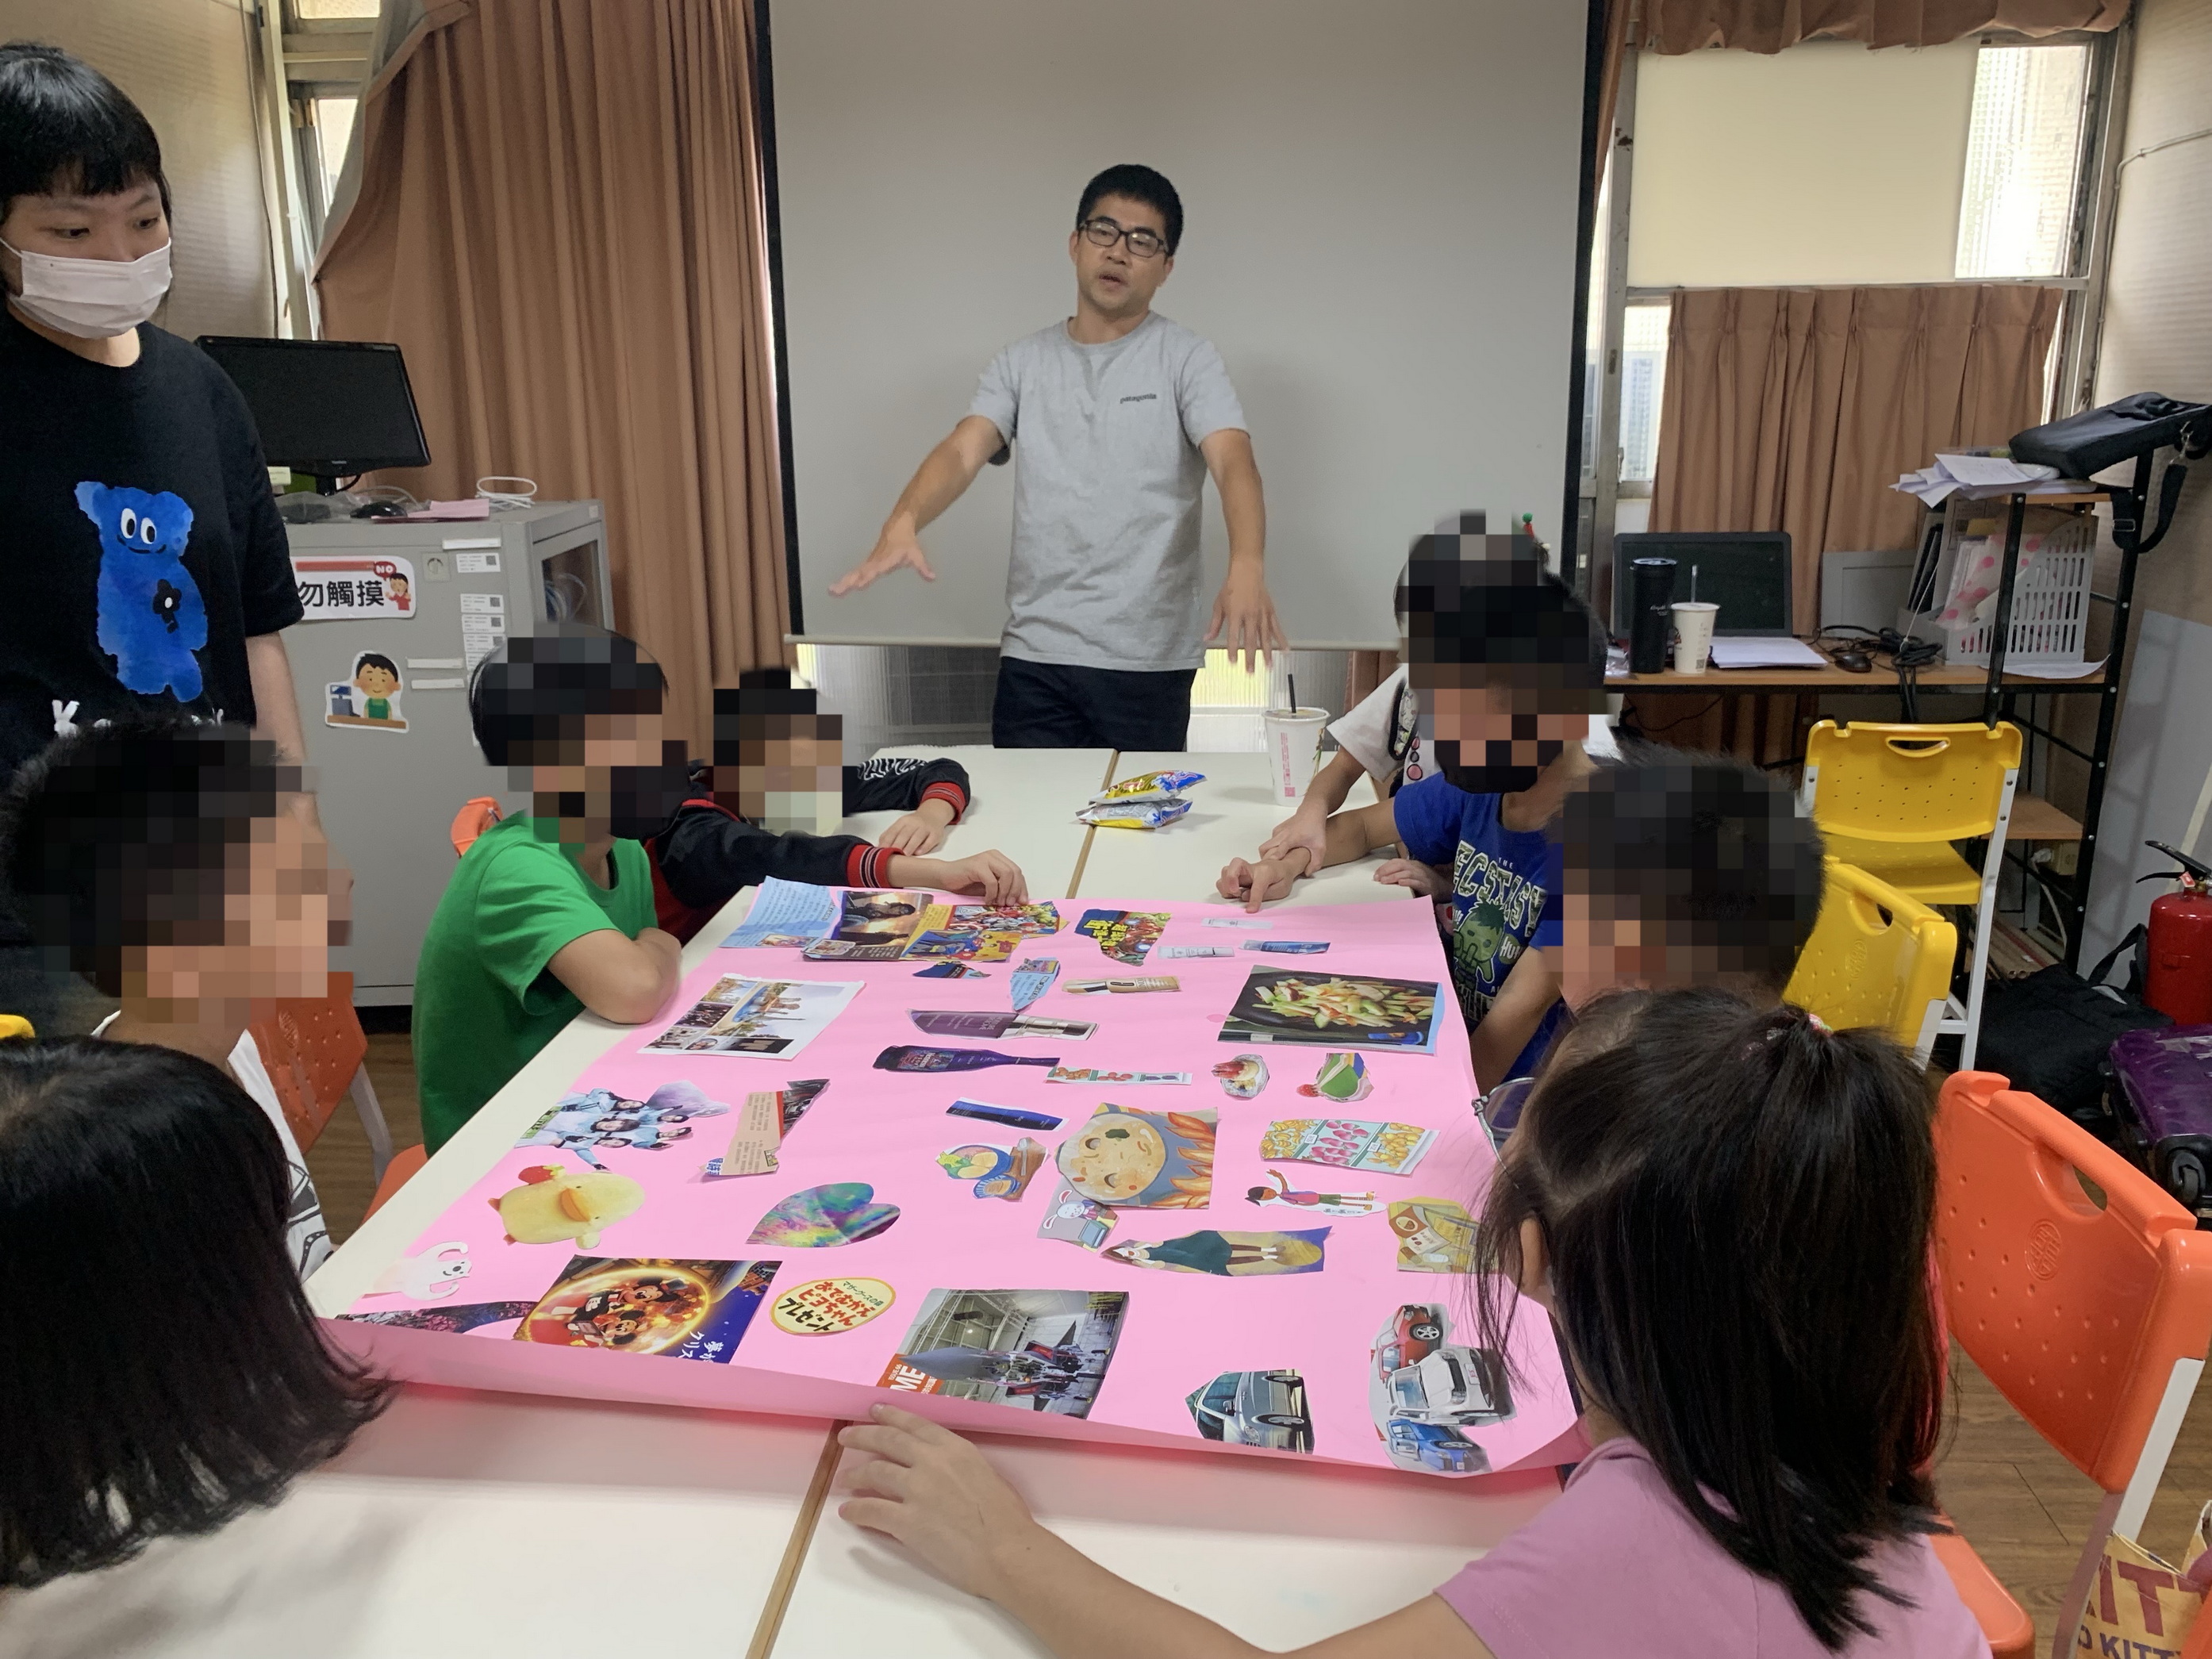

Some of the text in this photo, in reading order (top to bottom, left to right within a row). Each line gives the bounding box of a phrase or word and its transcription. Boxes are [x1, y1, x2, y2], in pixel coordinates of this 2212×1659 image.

[375, 565, 394, 574] NO
[298, 580, 385, 608] 勿觸摸
[1497, 857, 1514, 870] THE
[778, 1297, 835, 1332] プレゼント
